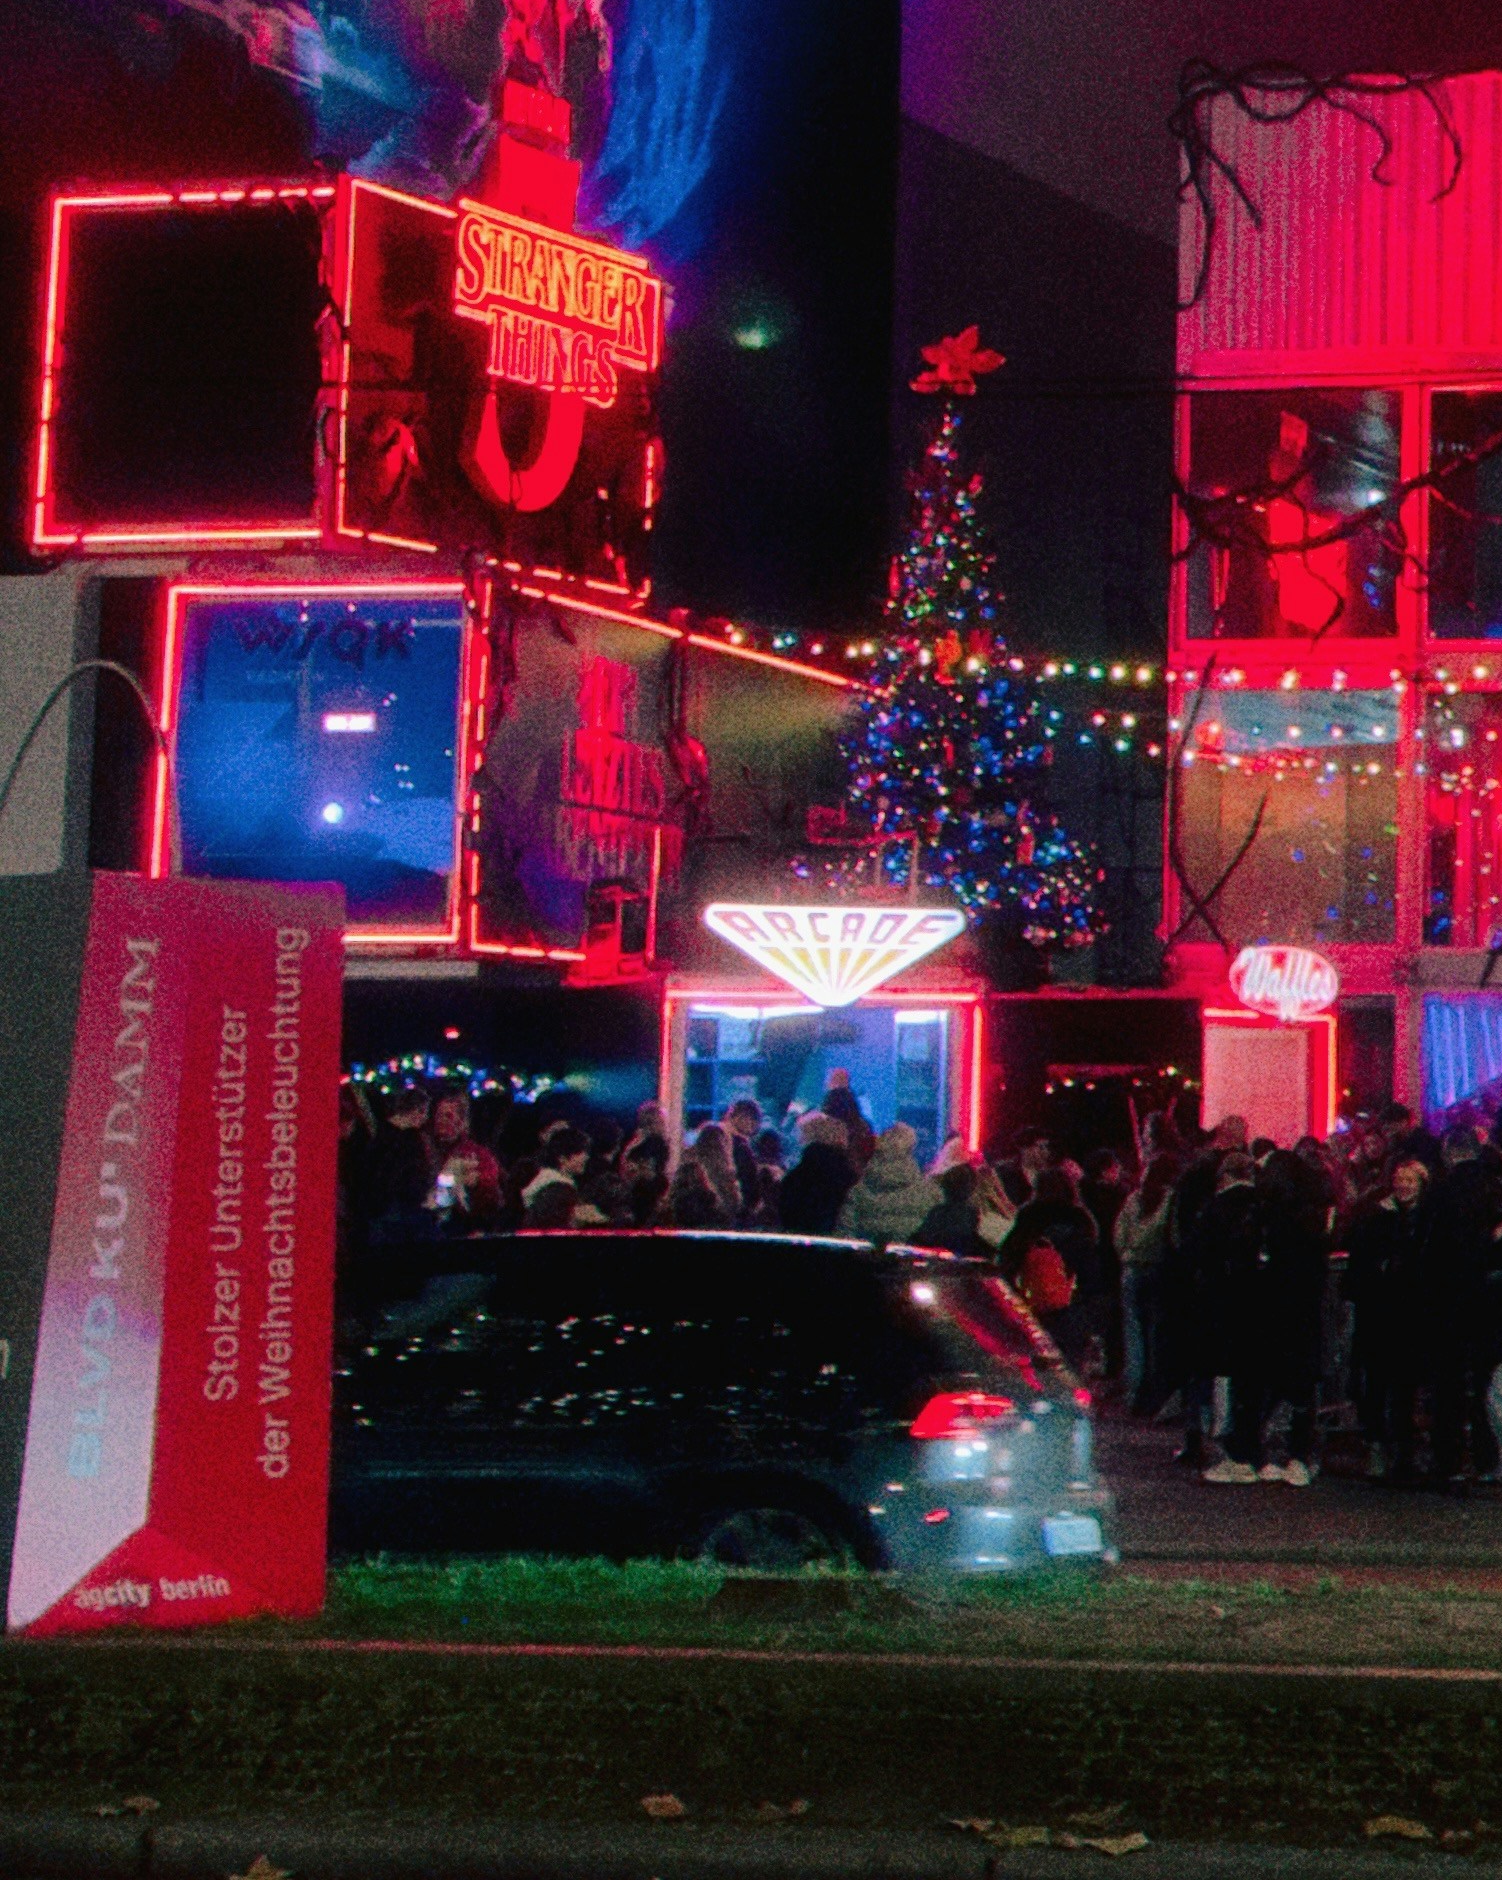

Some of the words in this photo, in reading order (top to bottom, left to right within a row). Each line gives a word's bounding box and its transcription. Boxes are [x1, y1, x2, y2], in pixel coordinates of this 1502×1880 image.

[455, 213, 648, 356] STRANGER
[487, 305, 618, 408] THINGS
[712, 910, 958, 945] ARCADE
[211, 1005, 250, 1253] Unterstützer
[258, 927, 311, 1406] Weihnachtsbeleuchtung
[205, 1261, 241, 1403] Stolzer
[258, 1412, 290, 1480] der
[158, 1574, 231, 1601] berlin
